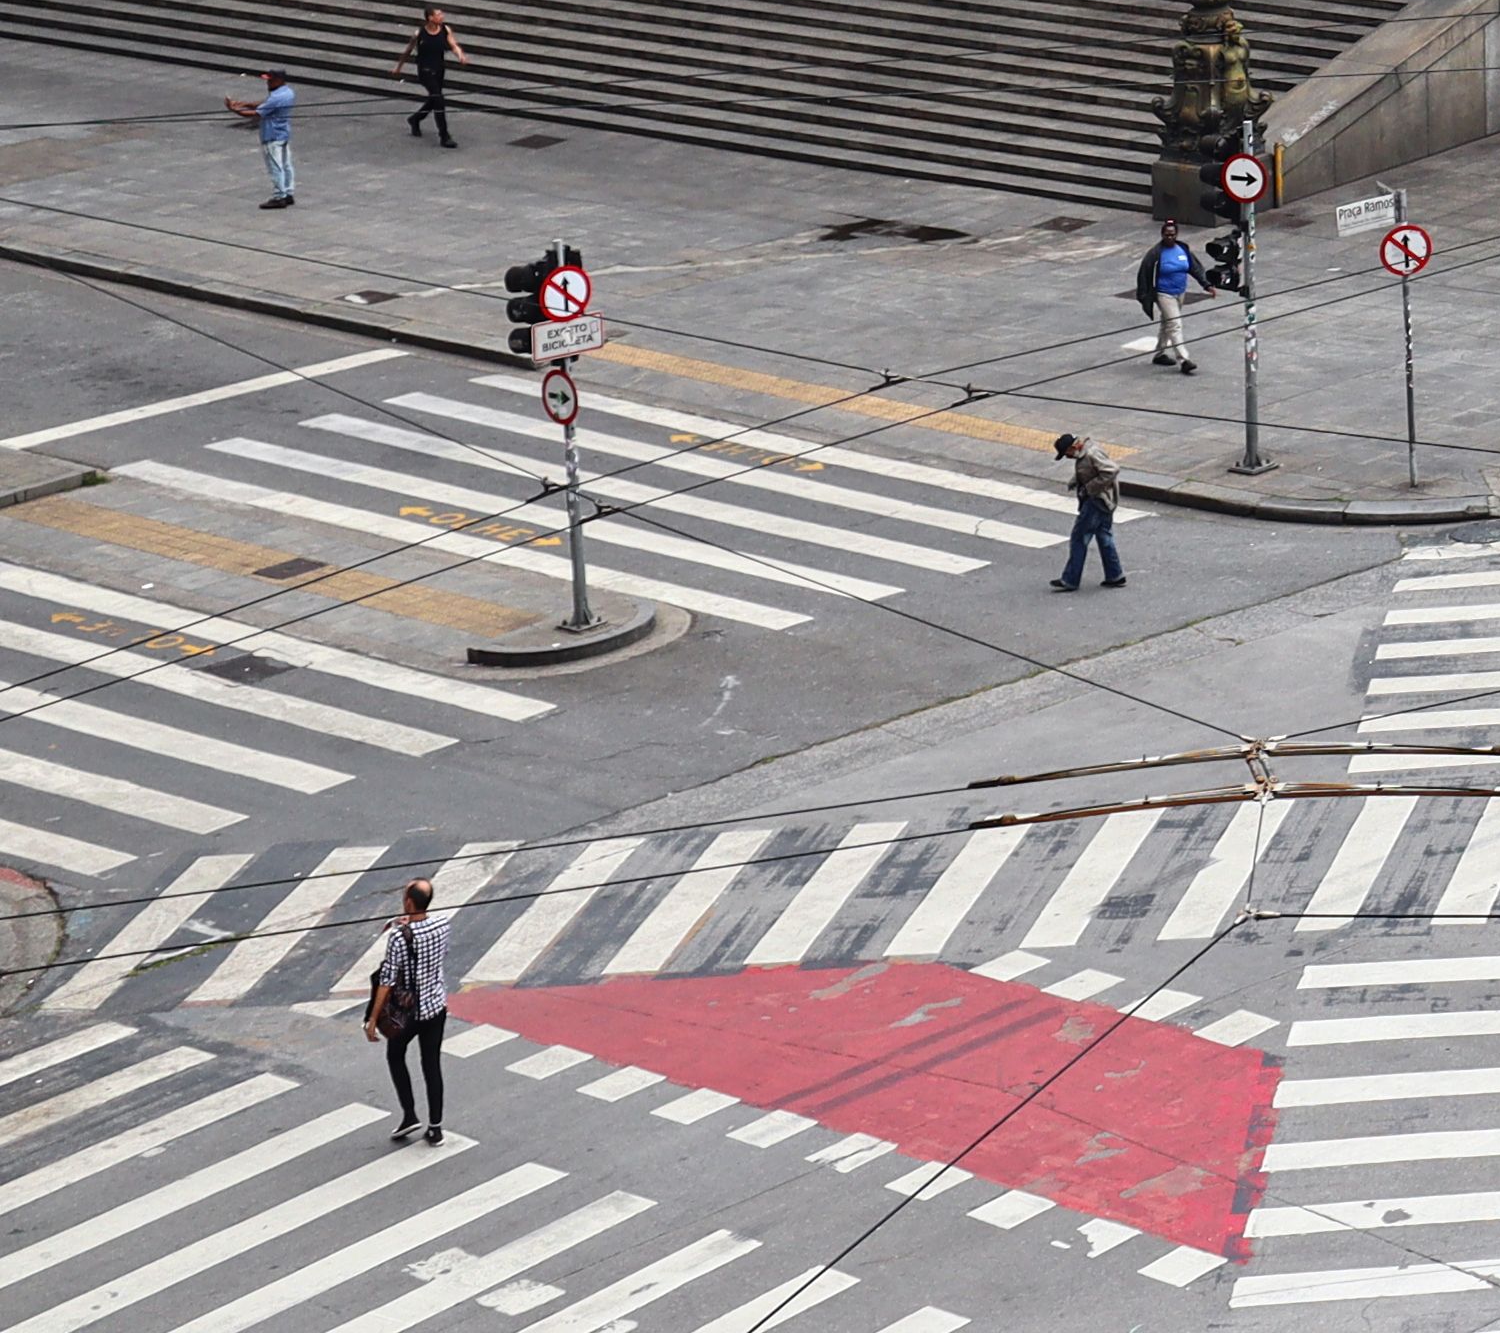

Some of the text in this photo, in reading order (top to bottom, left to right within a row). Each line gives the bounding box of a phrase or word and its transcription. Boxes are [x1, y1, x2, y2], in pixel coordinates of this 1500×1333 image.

[1338, 205, 1363, 221] Praça
[1363, 198, 1395, 214] Ramos
[541, 334, 594, 352] BICICETA
